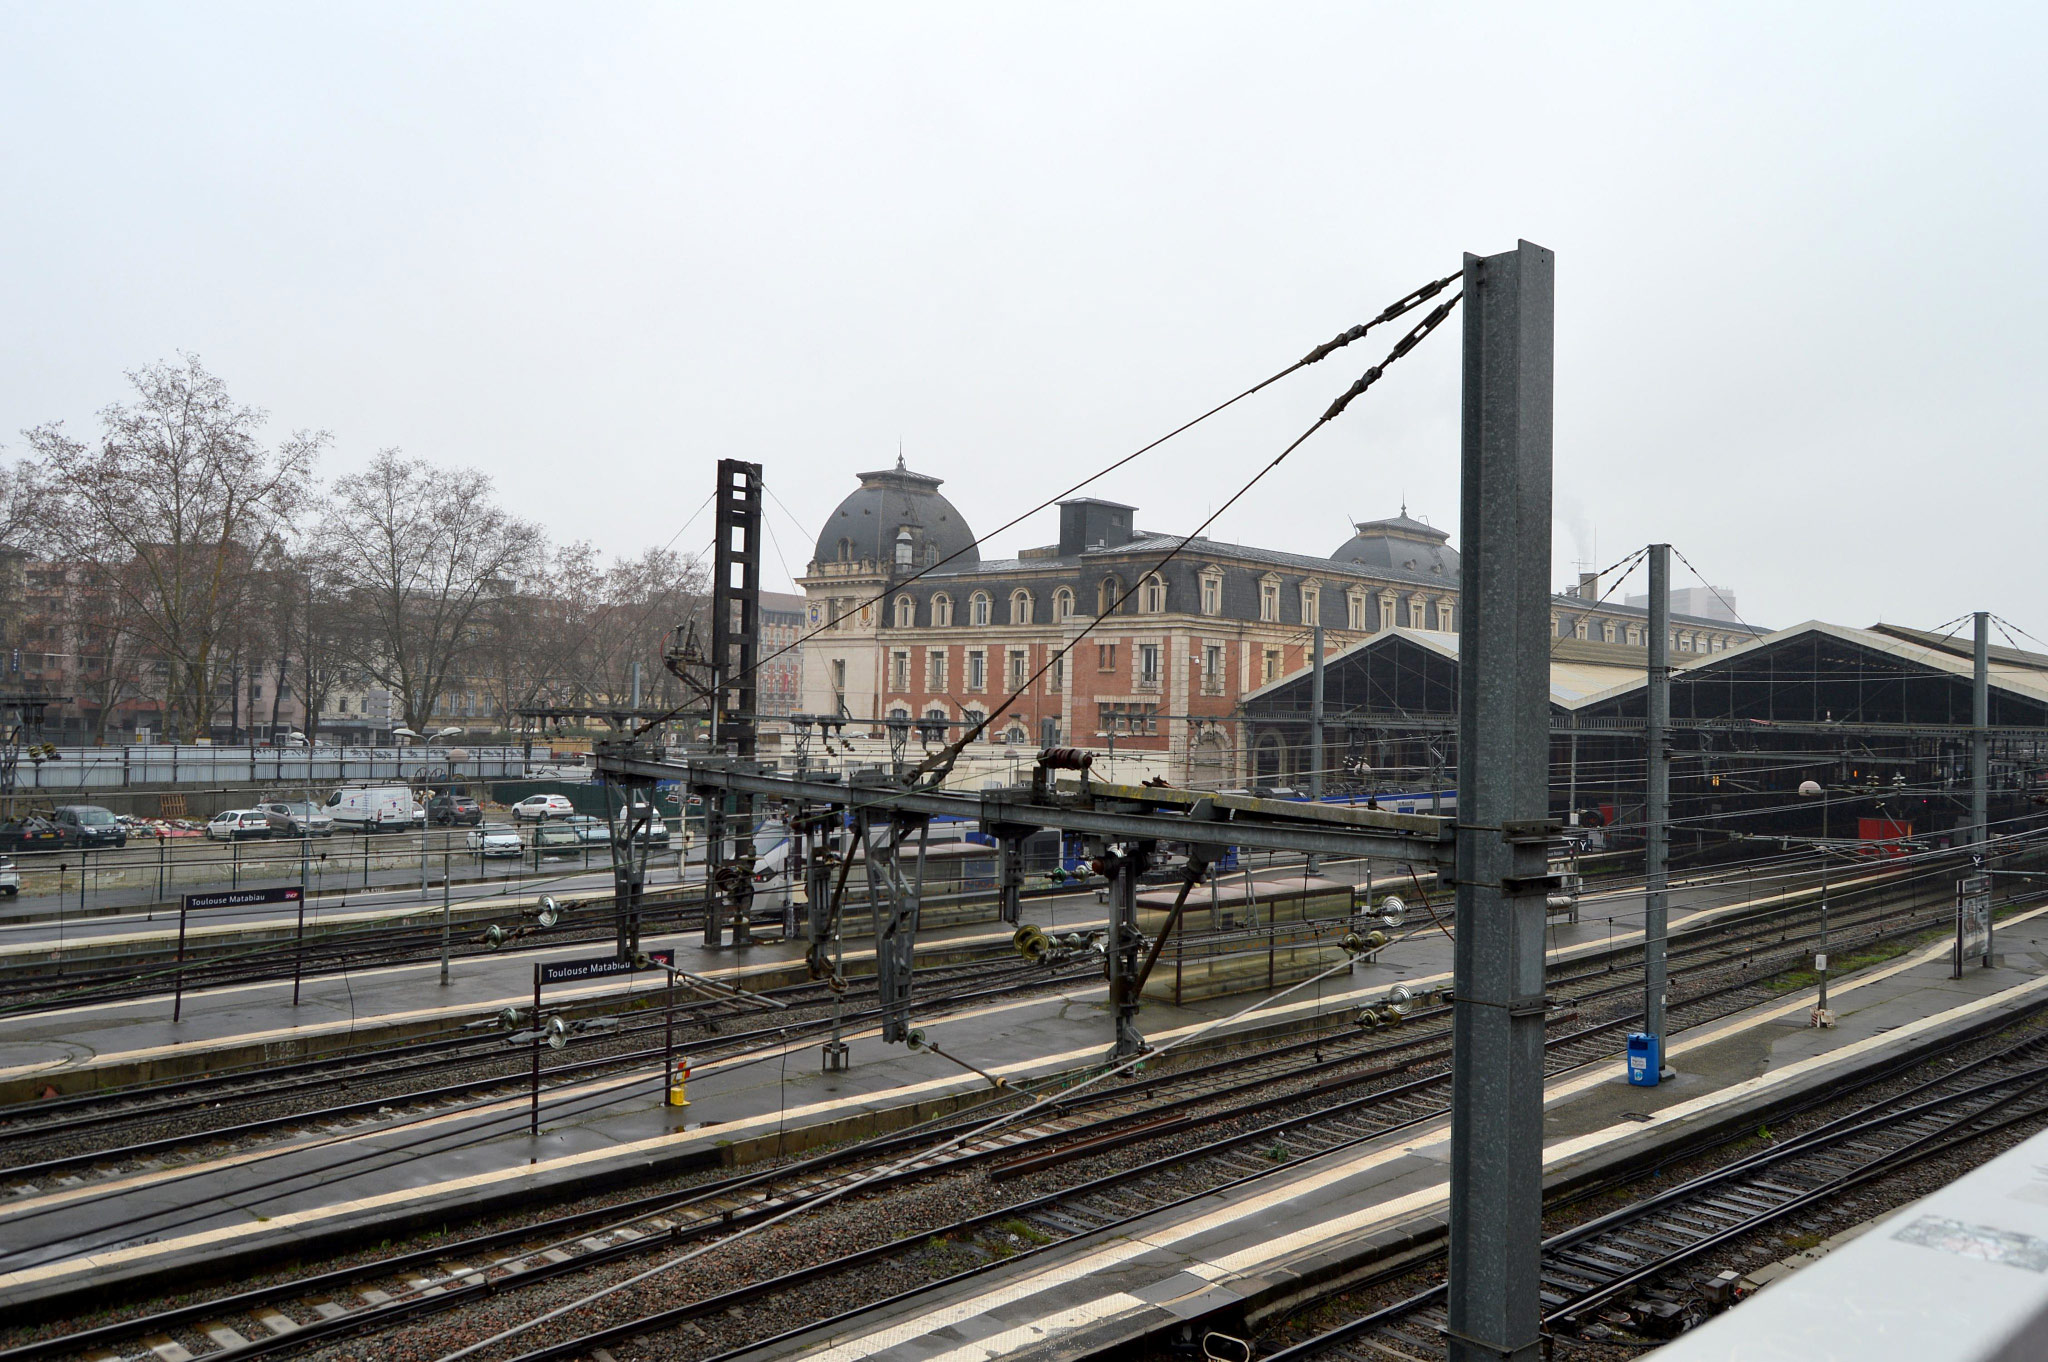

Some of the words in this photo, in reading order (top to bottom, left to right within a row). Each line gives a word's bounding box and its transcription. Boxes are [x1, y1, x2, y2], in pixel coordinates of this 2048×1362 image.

[191, 898, 228, 906] Toulouse
[229, 894, 265, 903] Matabiau
[548, 967, 588, 978] Toulouse
